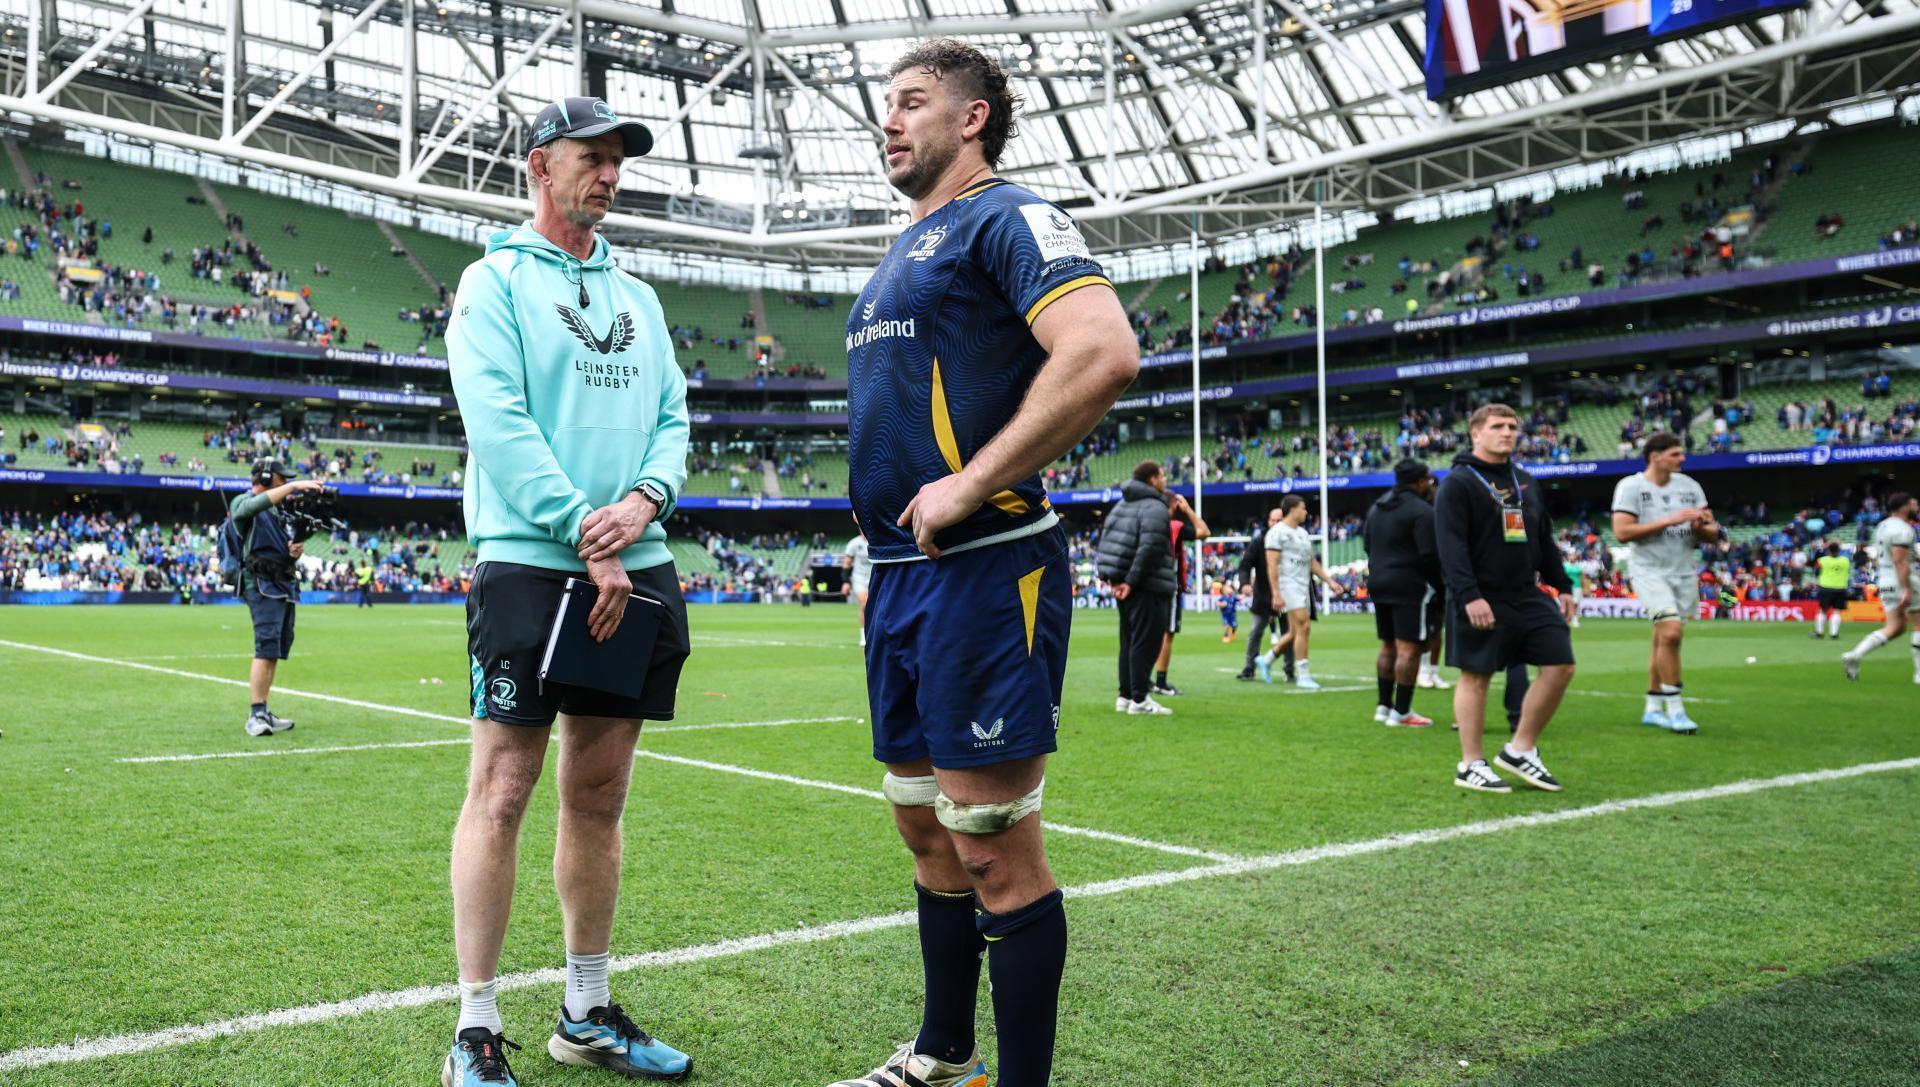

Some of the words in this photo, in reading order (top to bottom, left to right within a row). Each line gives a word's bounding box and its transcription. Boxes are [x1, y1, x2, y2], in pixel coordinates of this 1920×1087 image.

[1837, 251, 1876, 271] WHERE
[1405, 314, 1457, 333] Investec
[1479, 299, 1552, 322] CHAMPIONS
[1552, 296, 1581, 312] CUP
[854, 326, 867, 348] of
[866, 318, 915, 344] Ireland
[1781, 314, 1861, 335] Investec
[335, 349, 379, 364] Investec
[3, 361, 58, 378] Investec
[80, 367, 145, 385] CHAMPIONS
[146, 374, 169, 386] CUP
[575, 360, 640, 377] LEINSTER
[585, 375, 630, 389] RUGBY
[1215, 386, 1233, 398] CUP
[1758, 451, 1810, 465] Investec
[1833, 444, 1905, 460] CHAMPIONS
[500, 659, 510, 670] LC
[973, 739, 1005, 748] CASTORE
